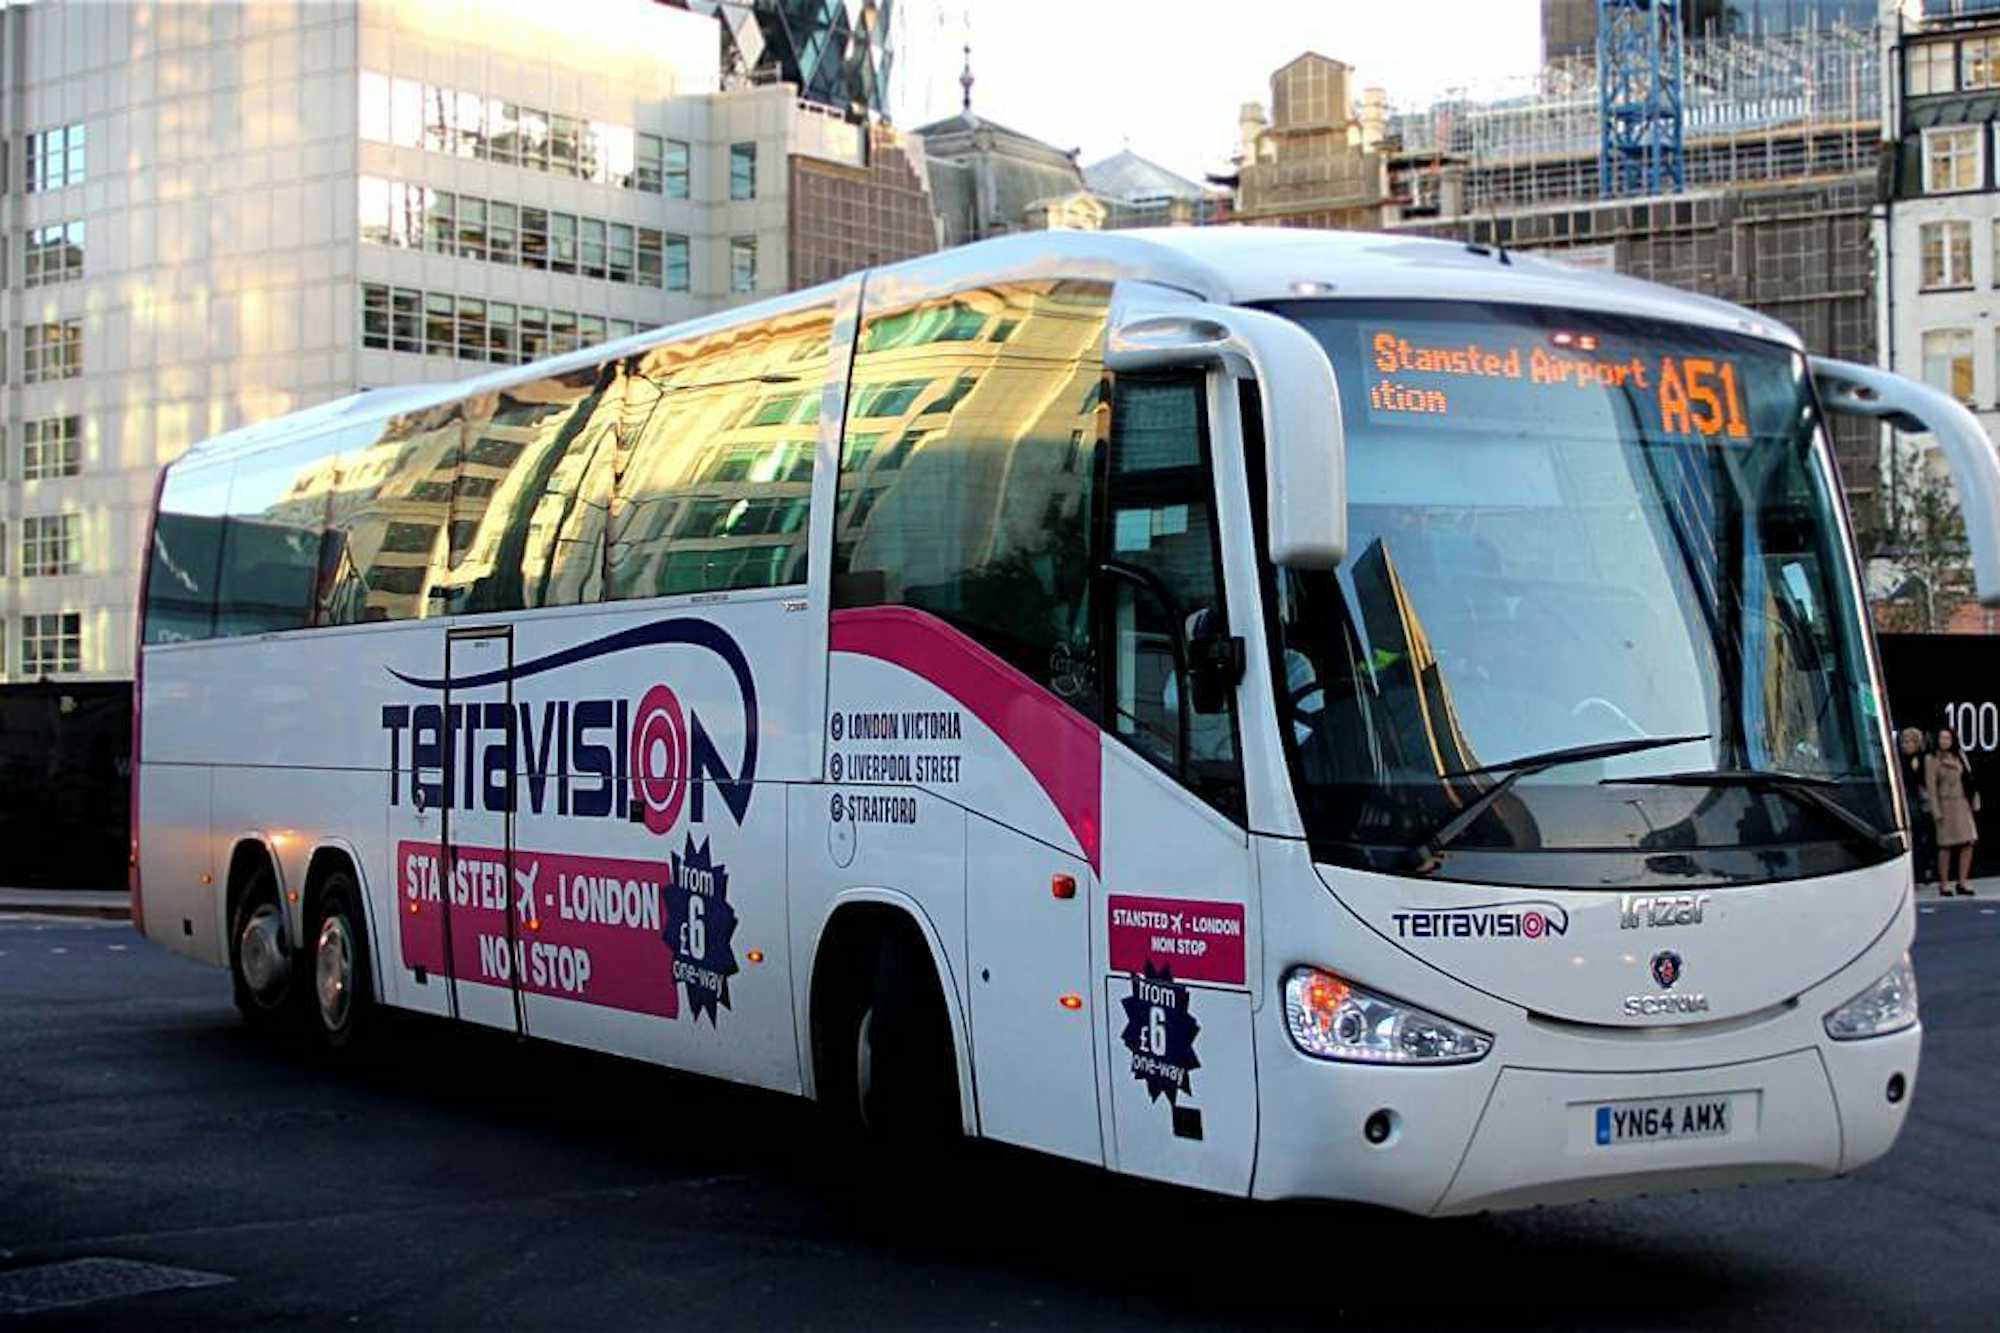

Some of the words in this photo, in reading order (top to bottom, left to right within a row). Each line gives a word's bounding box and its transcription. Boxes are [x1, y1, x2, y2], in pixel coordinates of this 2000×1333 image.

[1373, 331, 1521, 378] Stansted
[1529, 348, 1649, 389] Airport
[1658, 355, 1749, 438] A51
[849, 713, 898, 739] LONDON
[902, 713, 961, 739] VICTORIA
[1945, 702, 1998, 751] 100
[848, 754, 912, 781] LIVERPOOL
[916, 756, 961, 783] STREET
[849, 797, 916, 824] STRATFORD
[679, 855, 715, 896] from
[558, 874, 661, 930] LONDON
[680, 894, 705, 960] £6
[1113, 909, 1169, 930] STANSTED
[1192, 917, 1240, 936] LONDON
[1151, 936, 1176, 953] NON
[1177, 938, 1207, 956] STOP
[532, 942, 591, 993] STOP
[673, 960, 724, 998] one-way
[1138, 978, 1176, 1008] from
[1624, 994, 1709, 1016] SCANIA
[1140, 1006, 1166, 1057] £6
[1133, 1054, 1184, 1084] one-way
[1613, 1107, 1674, 1138] YN64
[1682, 1103, 1726, 1132] AMX
